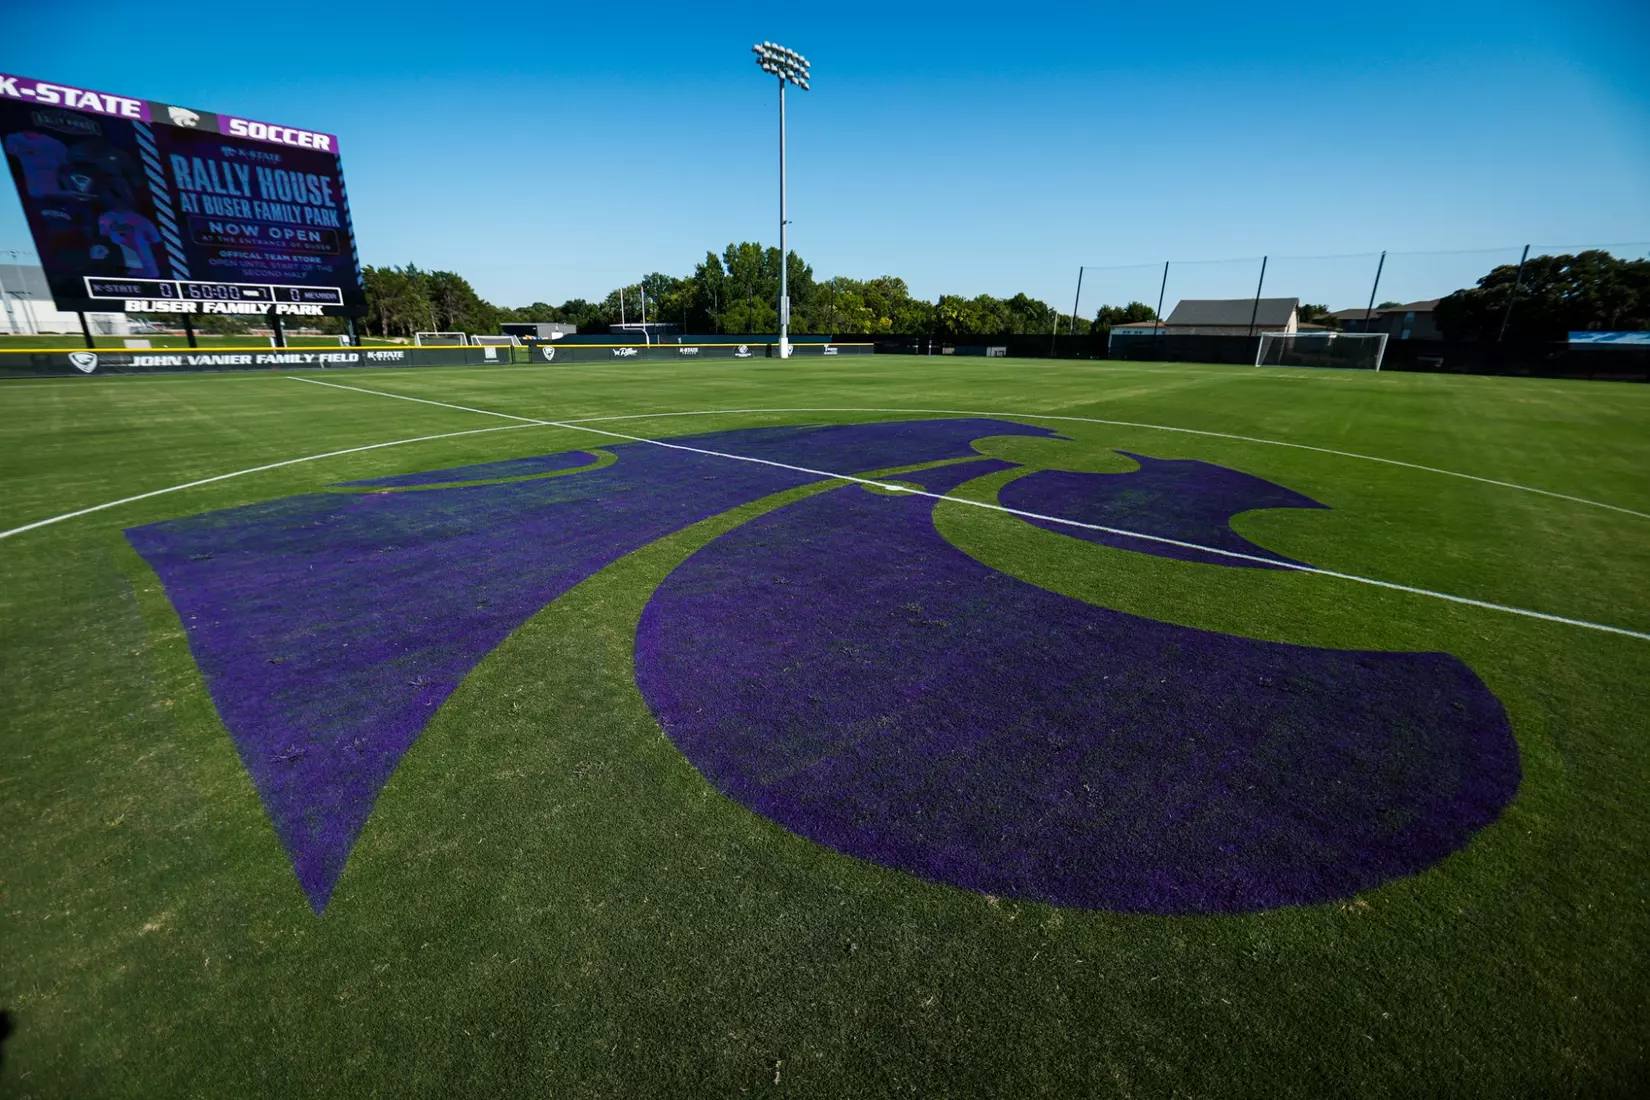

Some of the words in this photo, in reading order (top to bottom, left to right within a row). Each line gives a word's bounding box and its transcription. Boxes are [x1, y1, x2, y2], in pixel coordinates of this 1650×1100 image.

[0, 75, 141, 119] K-STATE
[229, 118, 331, 150] SOCCER
[169, 153, 251, 198] RALLY
[256, 165, 336, 207] HOUSE
[180, 191, 199, 213] AT
[201, 194, 252, 219] BUSER
[253, 201, 304, 224] FAMILY
[304, 206, 340, 228] PARK
[208, 221, 260, 237] NOW
[268, 227, 321, 242] OPEN
[264, 253, 291, 262] TEAM
[292, 255, 321, 264] STORE
[93, 284, 142, 294] K-STATE
[160, 283, 173, 298] 0
[188, 284, 240, 300] 60:00
[290, 288, 300, 302] 0
[124, 300, 197, 313] BUSER
[202, 302, 272, 315] FAMILY
[275, 304, 324, 316] PARK
[128, 355, 182, 367] JOHN
[187, 354, 252, 366] VANIER
[256, 353, 316, 364] FAMILY
[319, 352, 359, 363] FIELD
[367, 351, 404, 359] K-STATE
